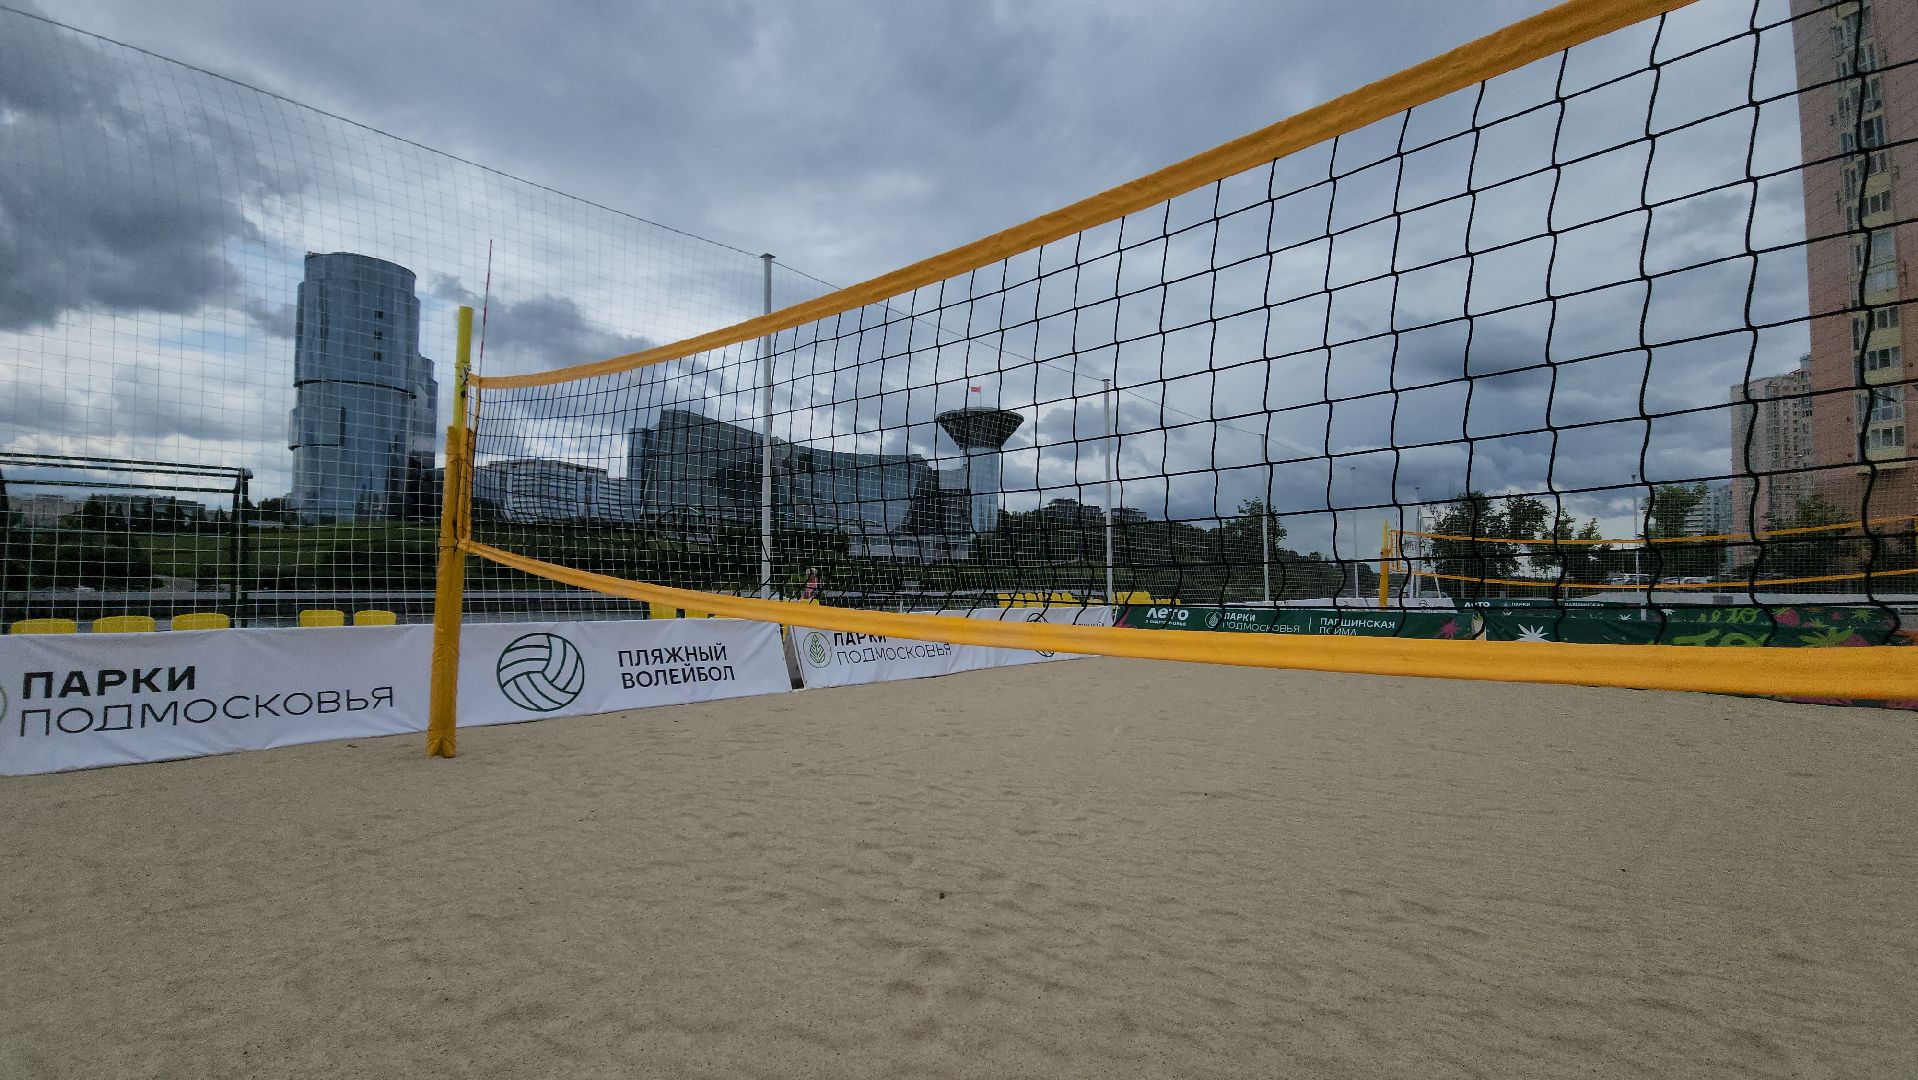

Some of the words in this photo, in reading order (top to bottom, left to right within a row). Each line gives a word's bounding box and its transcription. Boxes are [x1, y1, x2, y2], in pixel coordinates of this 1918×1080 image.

[1224, 612, 1256, 622] ПАРКИ
[618, 642, 727, 667] ПЛЯЖНЫЙ
[837, 642, 952, 665] ПОДМОСКОВЬЯ
[22, 665, 196, 700] ПАРКИ
[621, 662, 735, 689] ВОЛЕЙБОЛ
[20, 686, 394, 737] ПОДМОСКОВЬЯ
